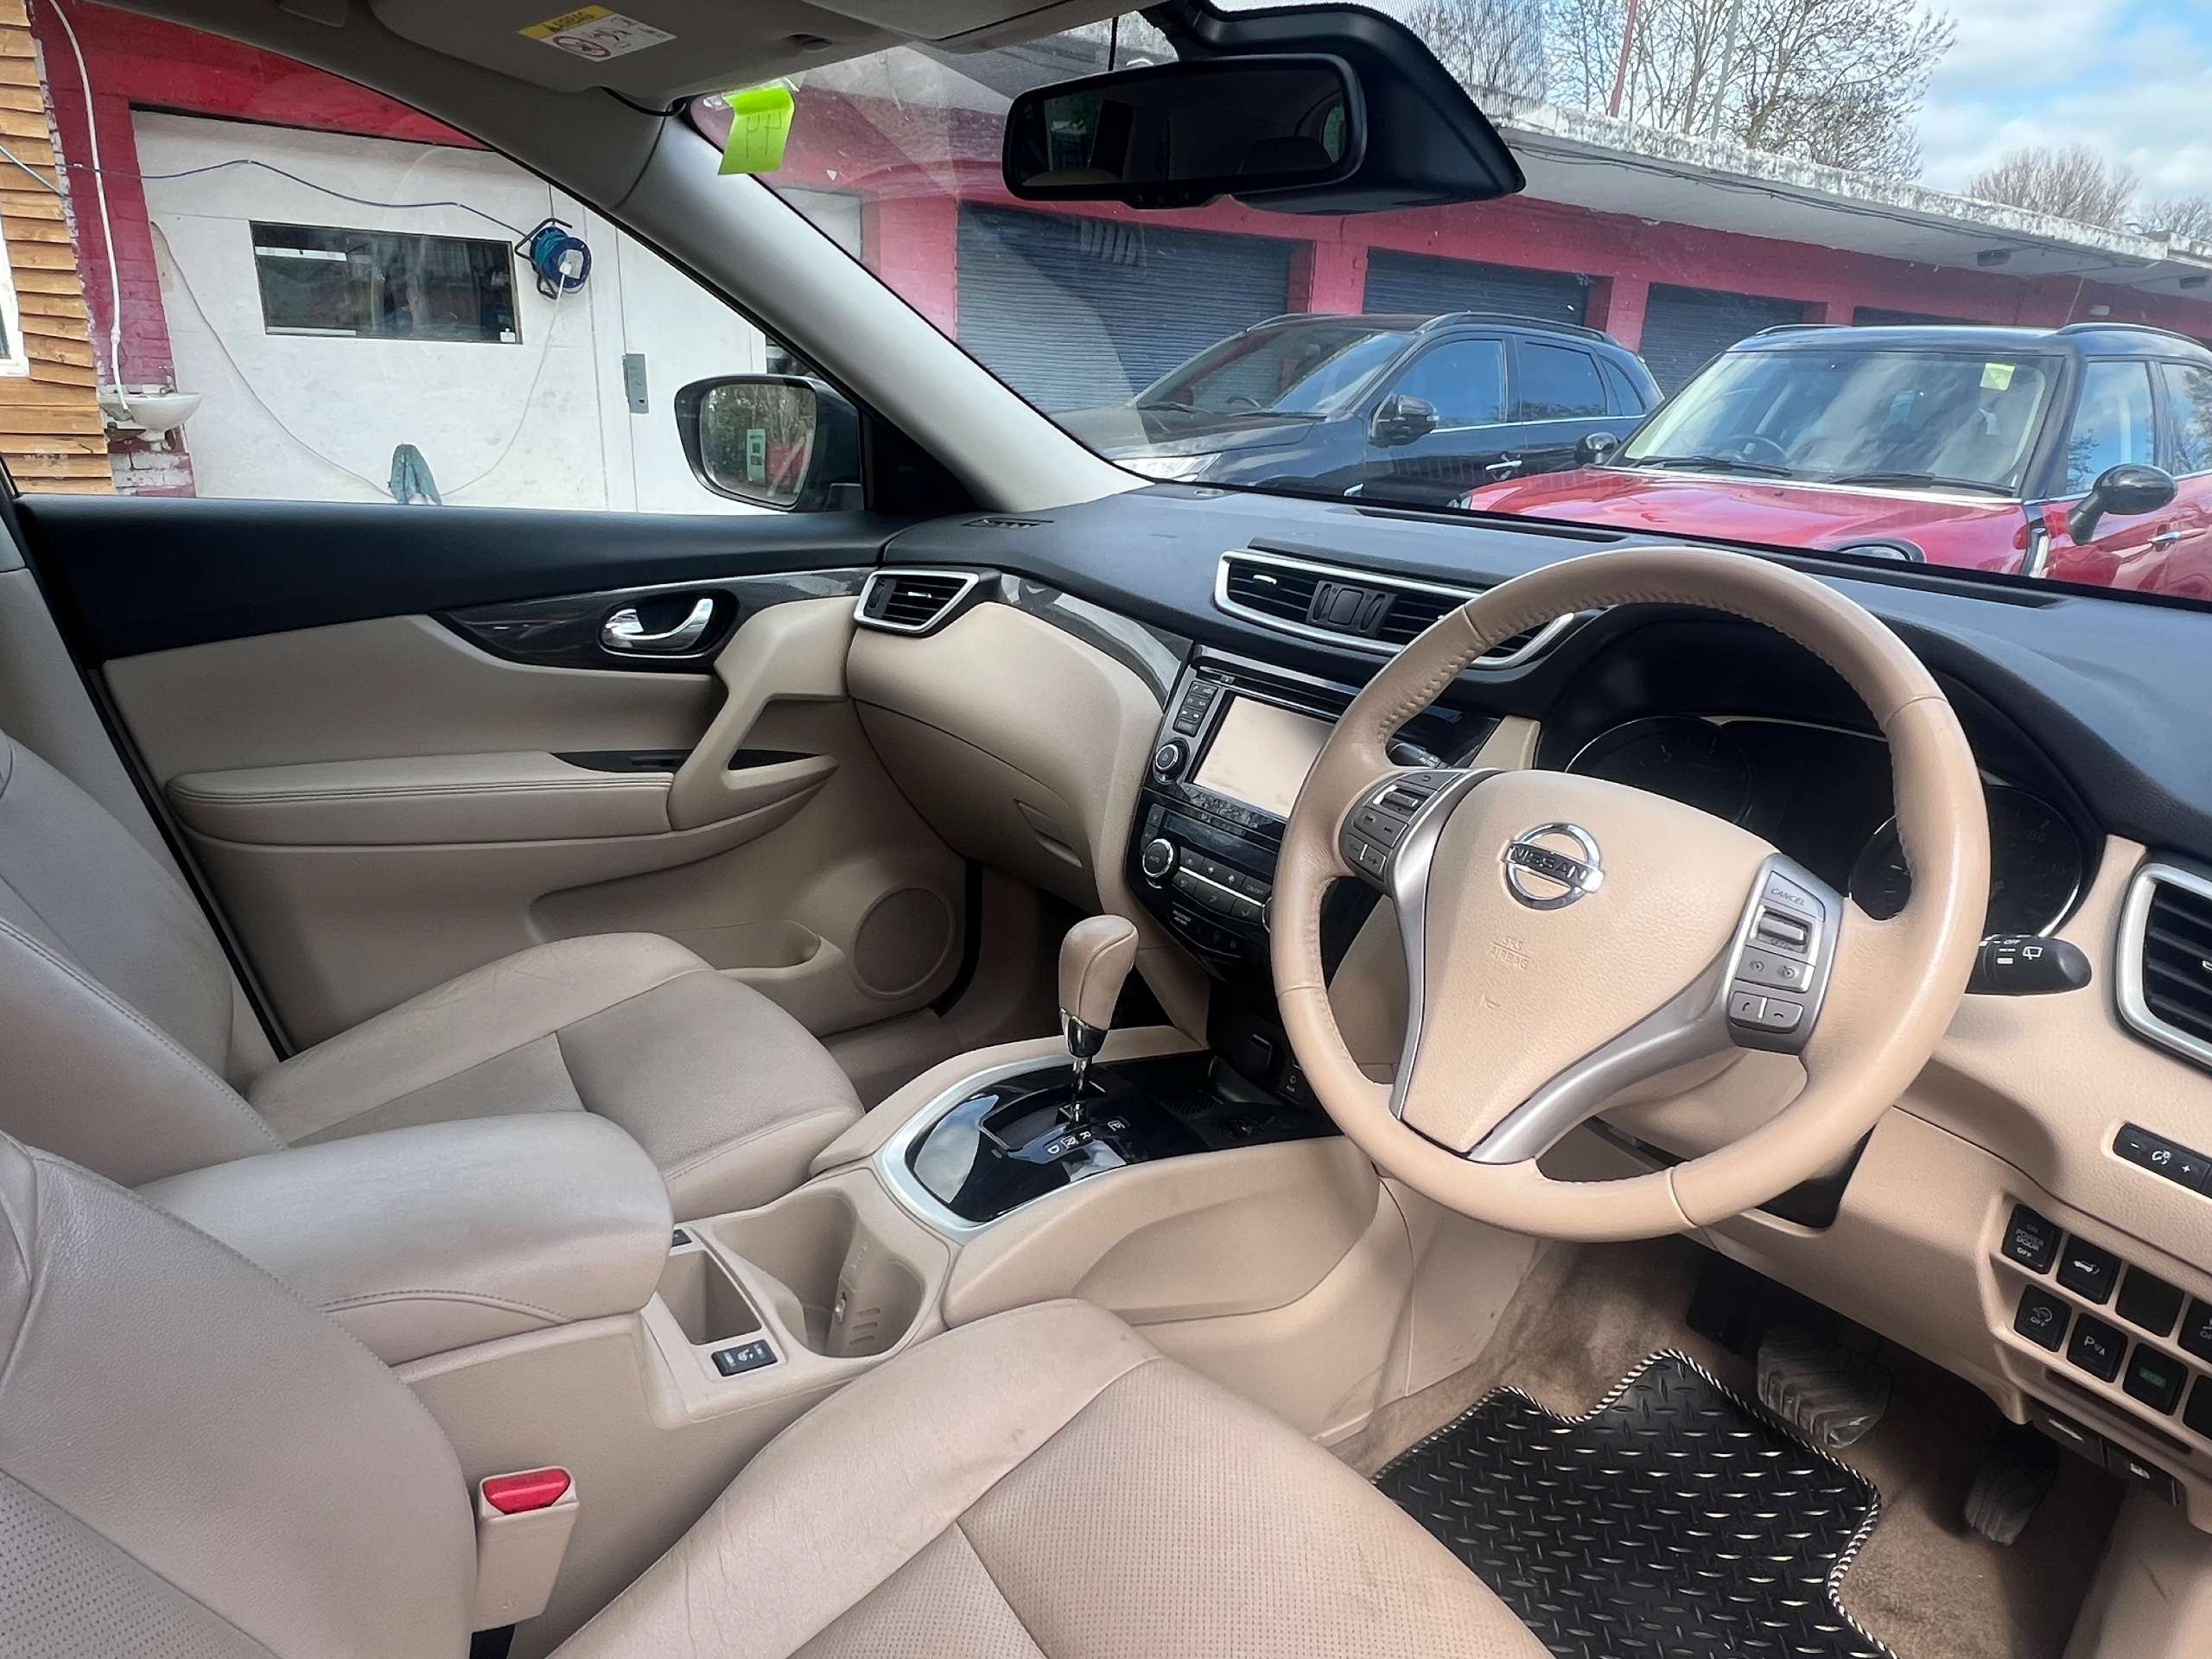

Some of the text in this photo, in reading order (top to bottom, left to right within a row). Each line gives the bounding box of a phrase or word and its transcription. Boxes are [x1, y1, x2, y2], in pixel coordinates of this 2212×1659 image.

[1506, 844, 1588, 883] NISSAN
[1770, 888, 1805, 906] CANCEL
[1502, 936, 1524, 950] SRS
[1079, 1131, 1091, 1140] R
[1047, 1144, 1060, 1154] D
[2017, 1247, 2032, 1258] OFF
[2083, 1334, 2096, 1347] P
